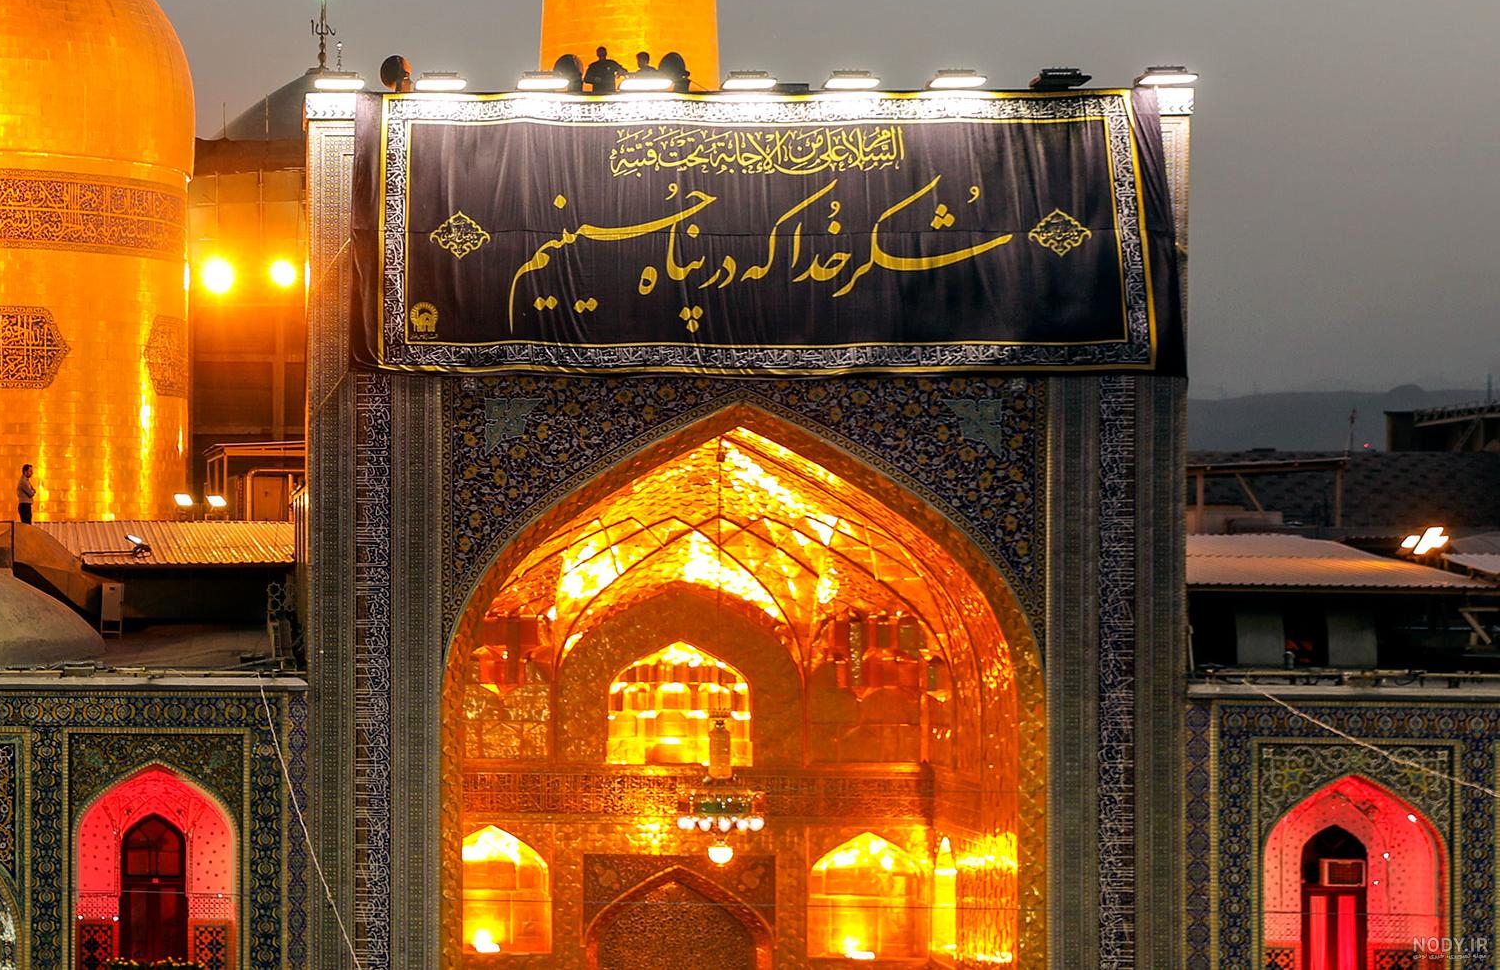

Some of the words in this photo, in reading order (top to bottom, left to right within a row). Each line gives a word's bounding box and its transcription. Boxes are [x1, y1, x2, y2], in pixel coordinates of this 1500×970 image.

[637, 221, 706, 334] پناه
[698, 254, 737, 290] در
[740, 178, 838, 282] که
